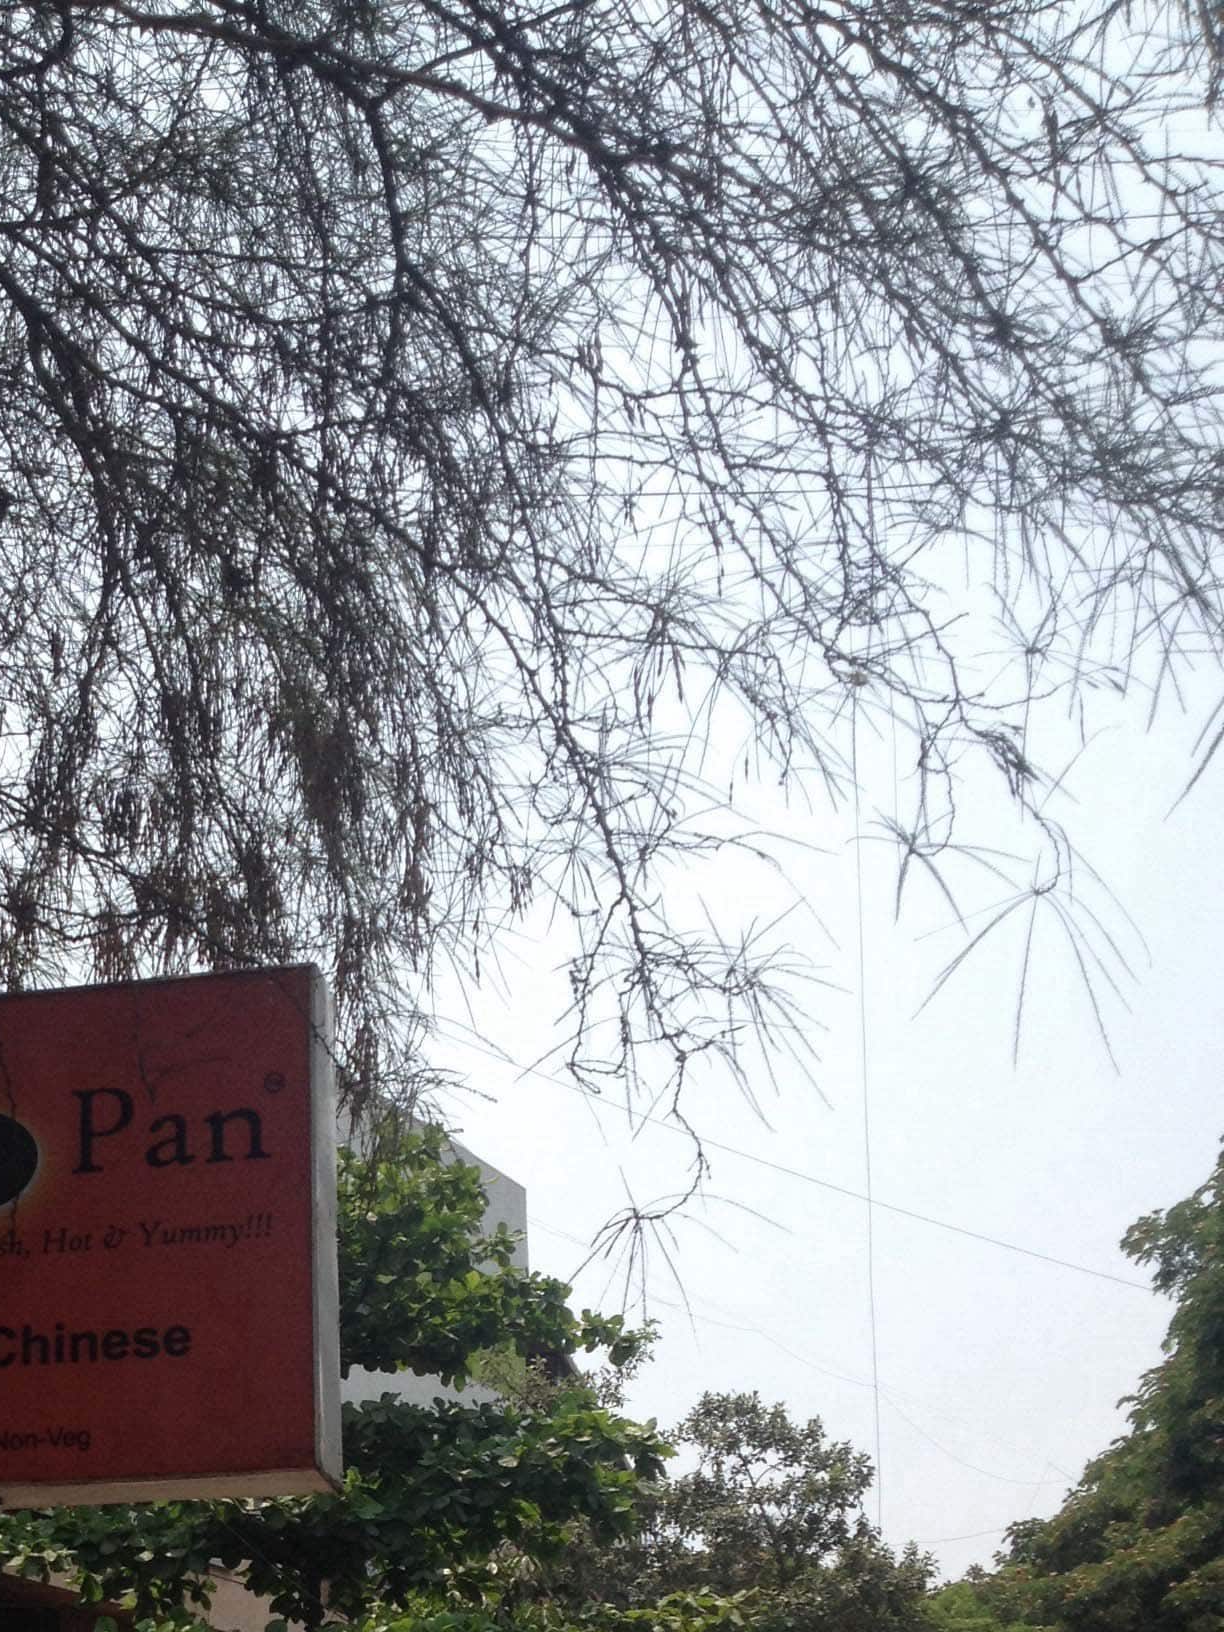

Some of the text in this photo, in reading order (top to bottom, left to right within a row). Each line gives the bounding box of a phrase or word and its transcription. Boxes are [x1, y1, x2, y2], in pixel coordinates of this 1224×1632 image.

[72, 1087, 271, 1173] Pan
[43, 1228, 92, 1254] Hot
[103, 1224, 130, 1250] &
[139, 1213, 273, 1249] Yummy!!!
